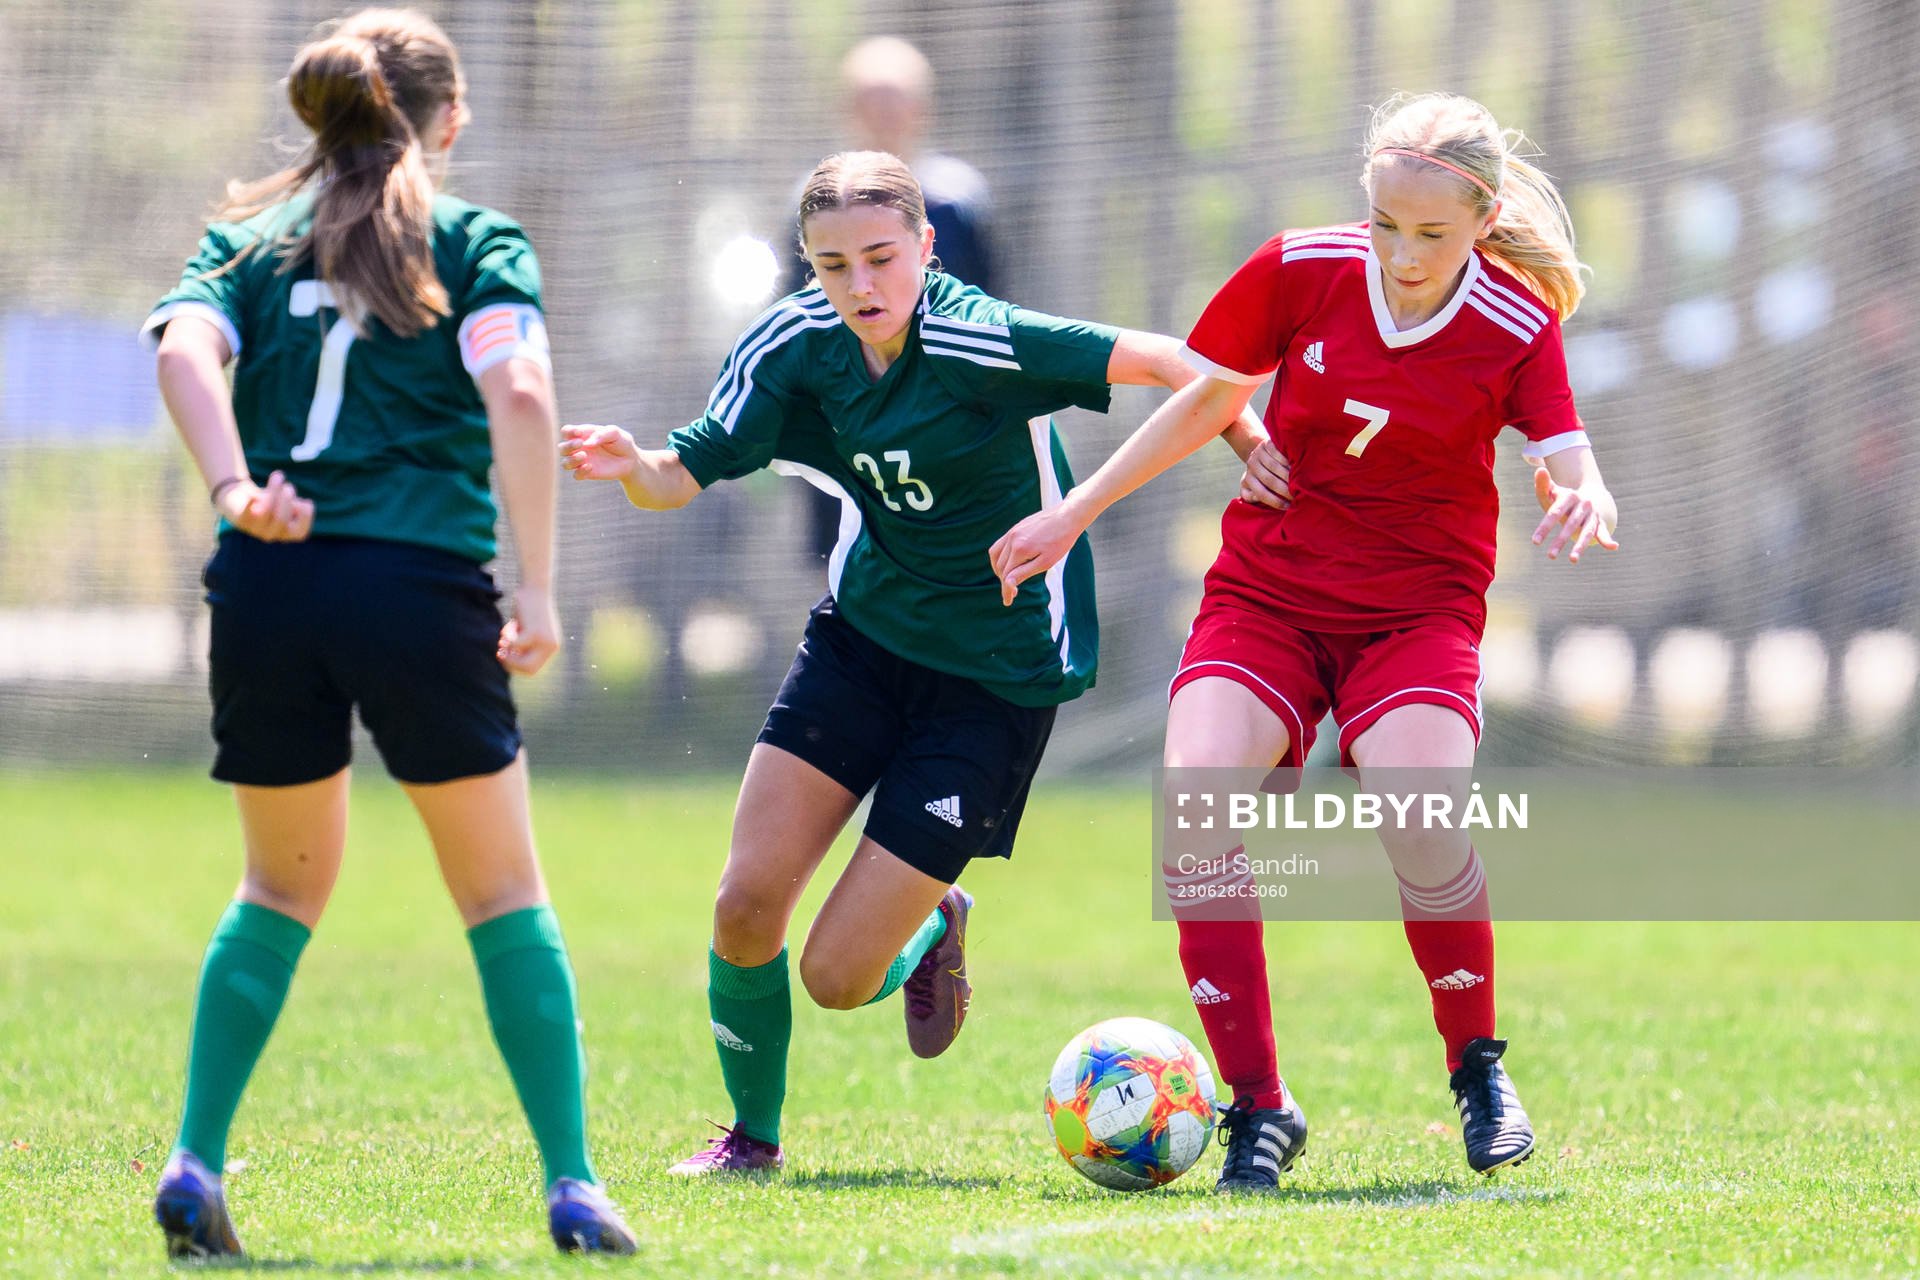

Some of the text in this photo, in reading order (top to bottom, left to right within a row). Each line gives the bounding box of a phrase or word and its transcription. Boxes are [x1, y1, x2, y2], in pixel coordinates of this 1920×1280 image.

[289, 279, 369, 462] 7
[1343, 398, 1390, 458] 7
[853, 450, 933, 511] 23
[925, 802, 963, 828] adidas
[1431, 975, 1485, 990] adidas
